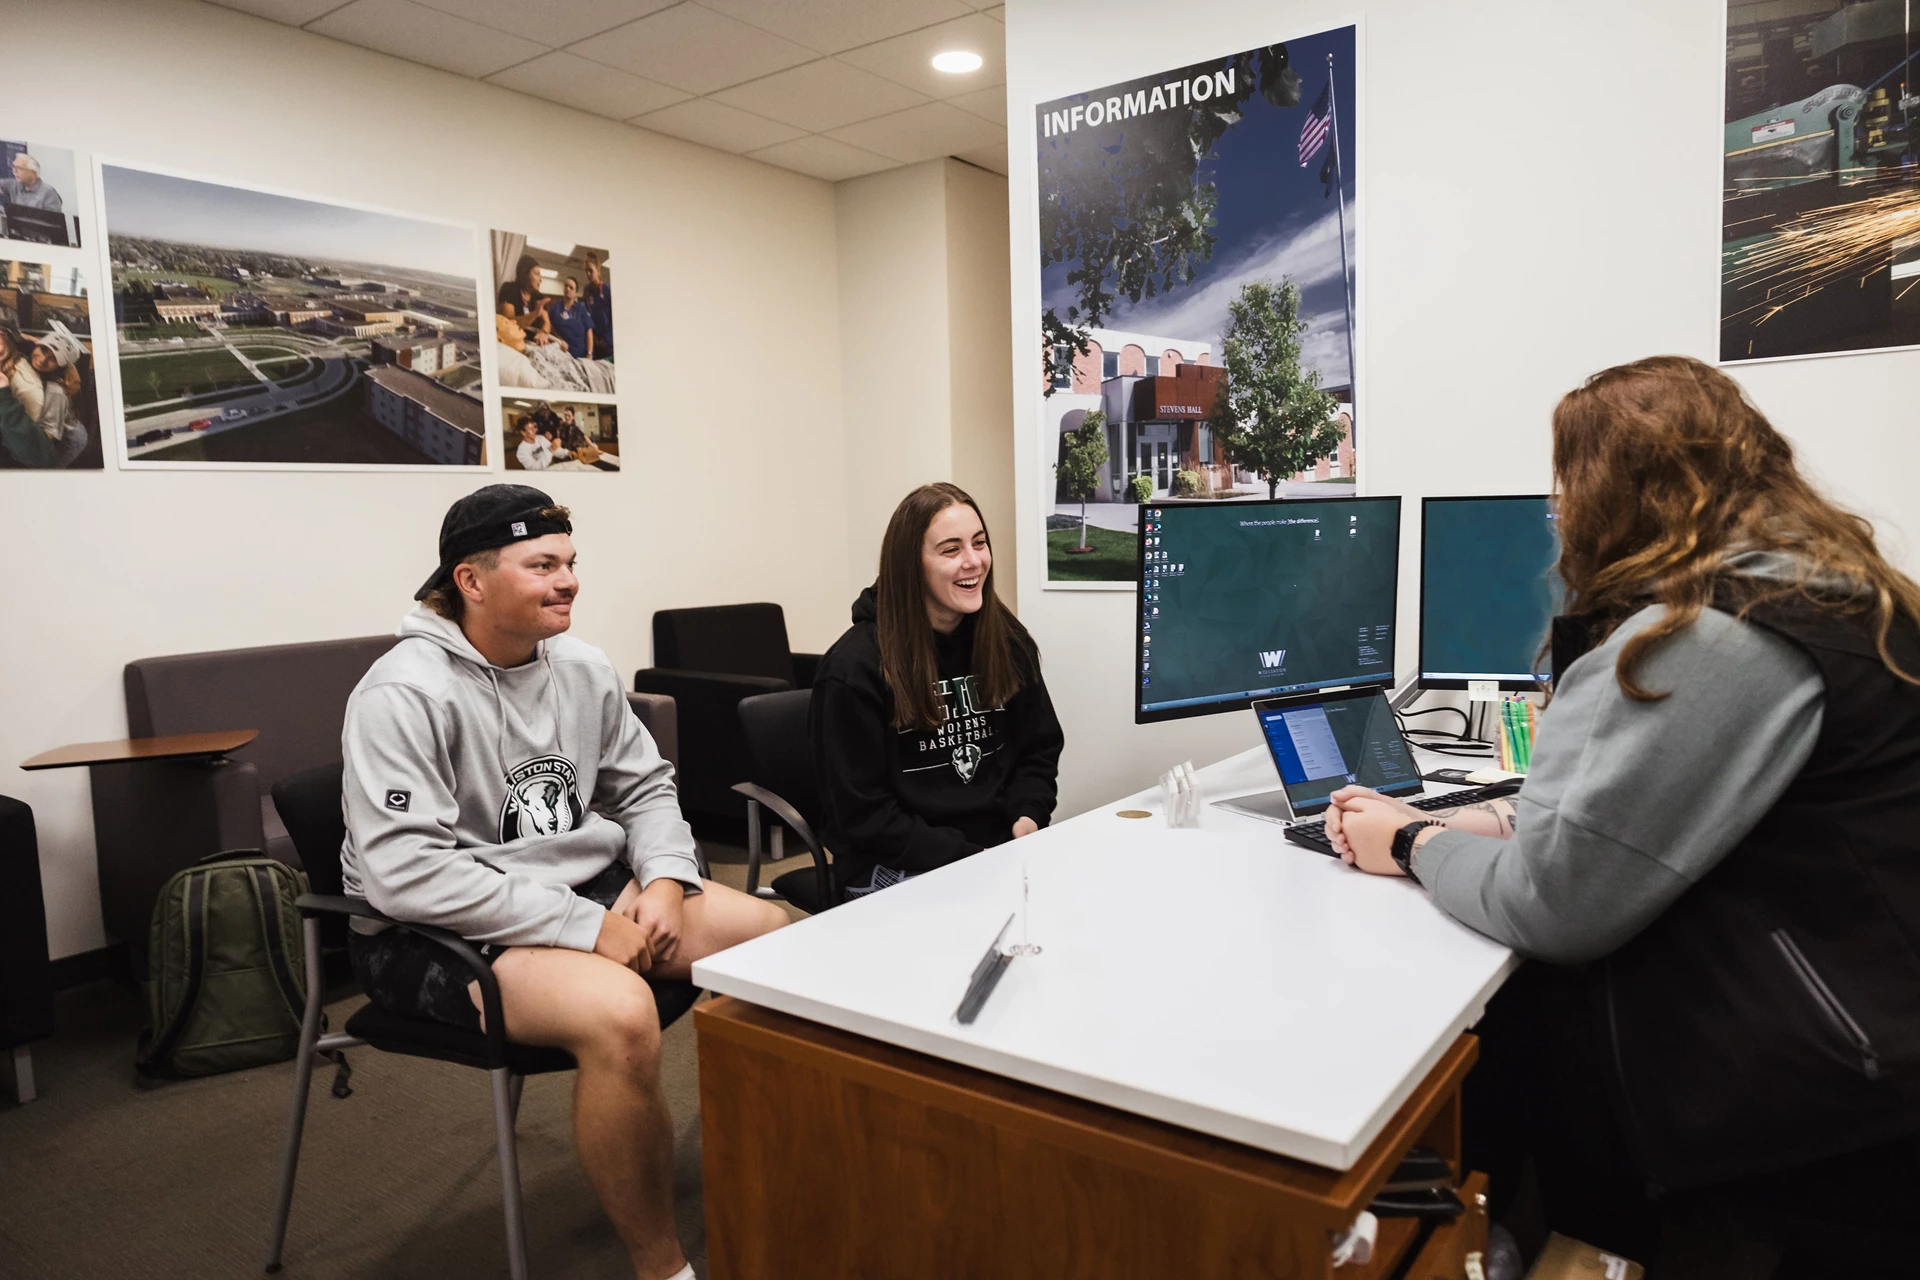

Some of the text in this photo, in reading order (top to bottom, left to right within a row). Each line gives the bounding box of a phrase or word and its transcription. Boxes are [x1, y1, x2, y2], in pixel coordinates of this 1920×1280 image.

[1043, 67, 1236, 138] INFORMATION
[1159, 405, 1203, 414] STEVENS HALL
[919, 726, 1000, 752] BASKETBAL
